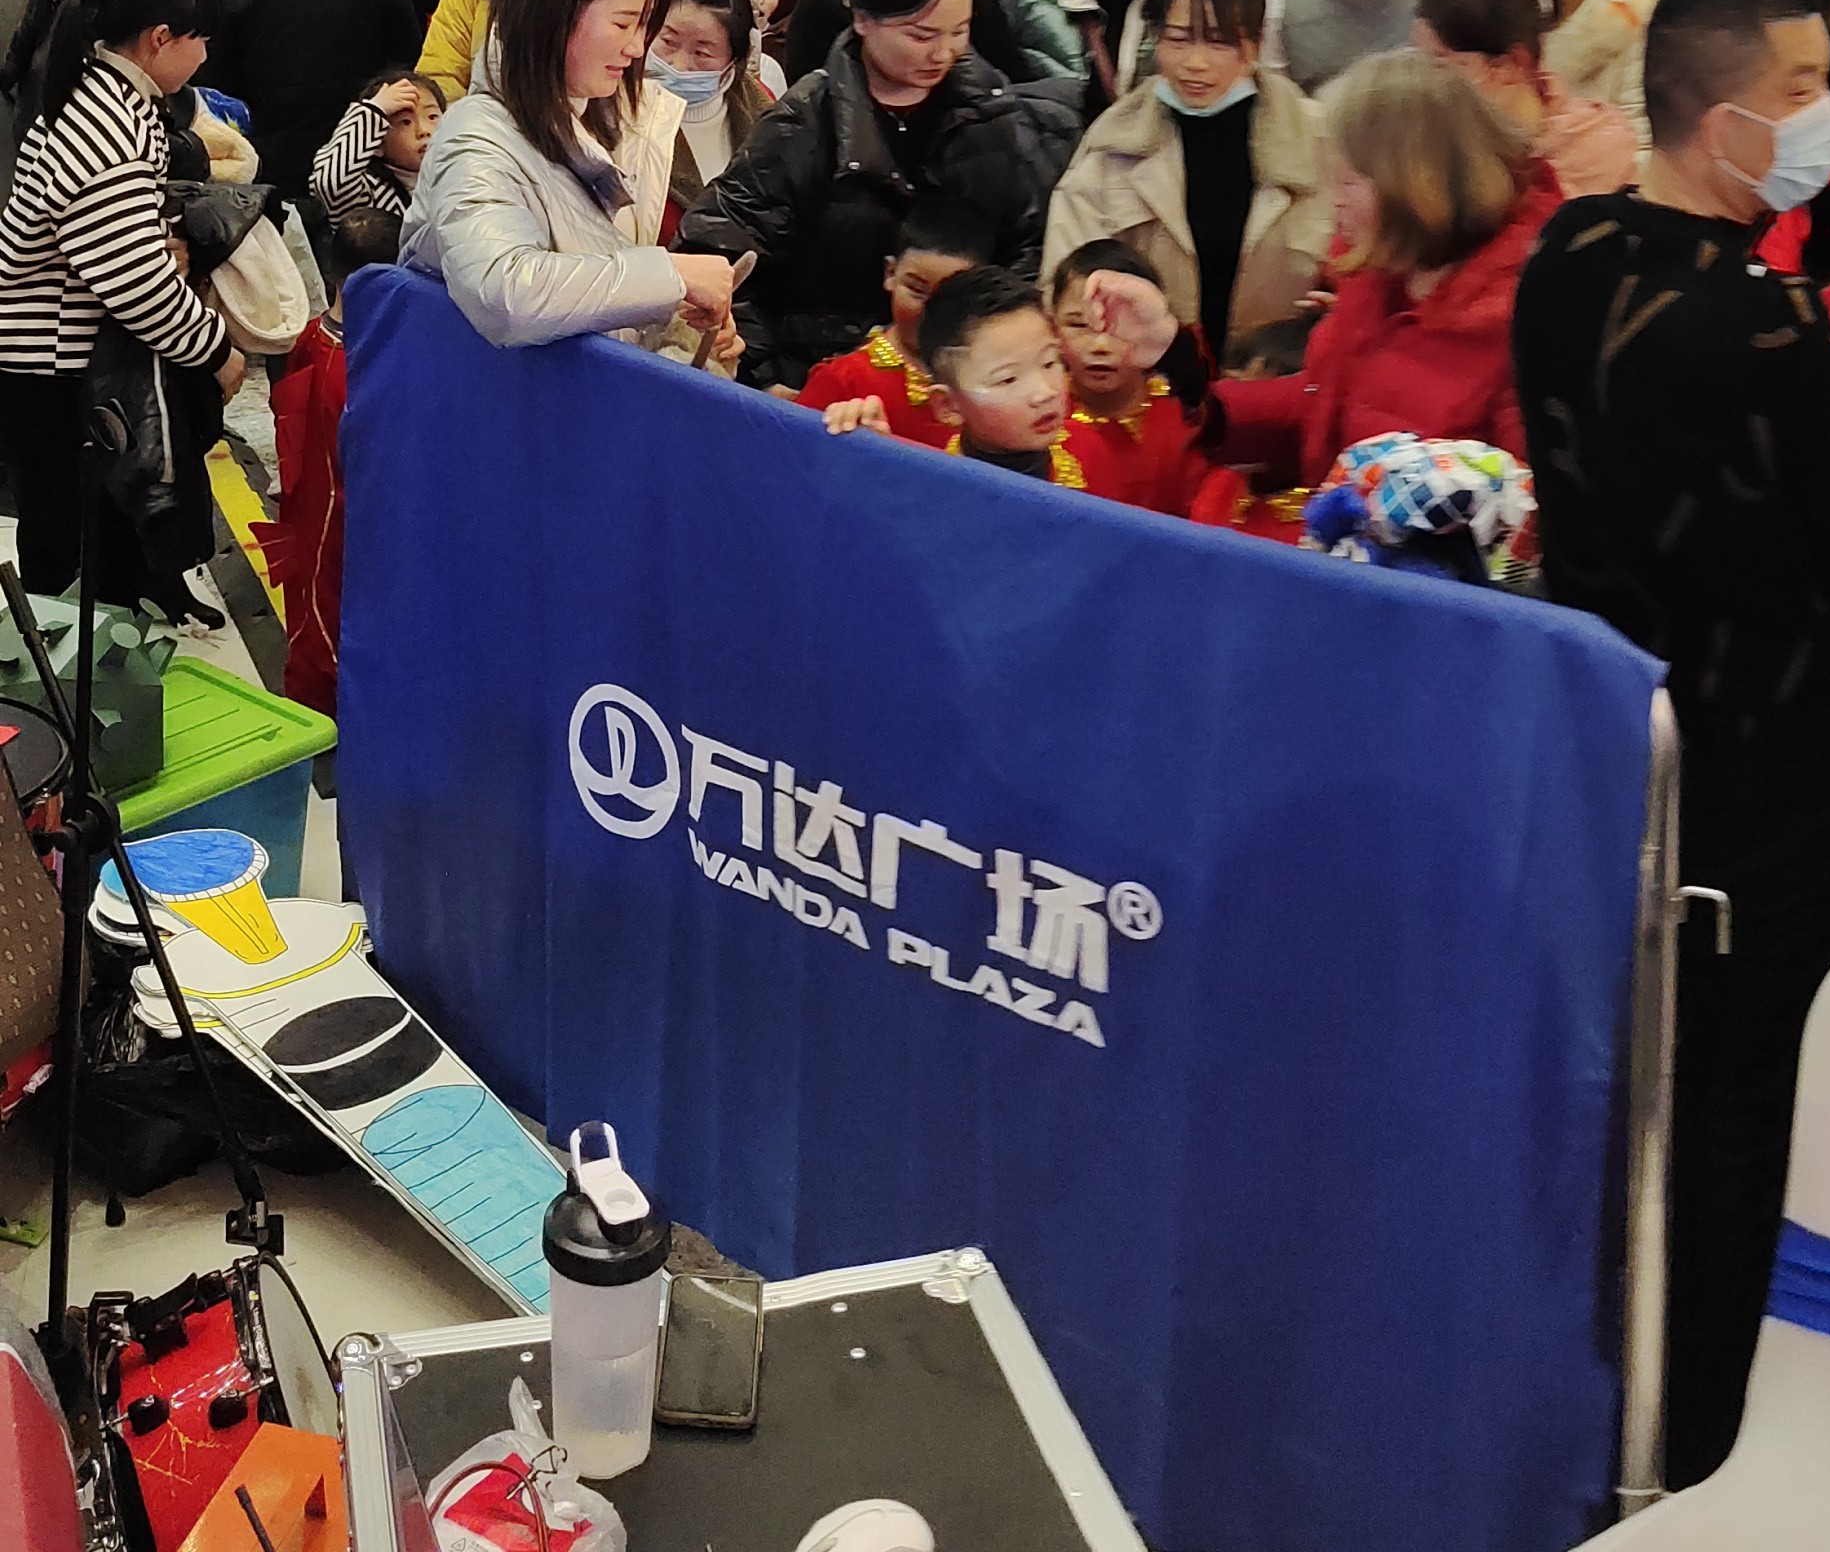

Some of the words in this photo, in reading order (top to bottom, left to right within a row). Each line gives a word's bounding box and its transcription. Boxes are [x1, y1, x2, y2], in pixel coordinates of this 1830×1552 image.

[682, 723, 1109, 994] 万达广场
[688, 827, 871, 950] WANDA
[887, 927, 1107, 1048] PLAZA
